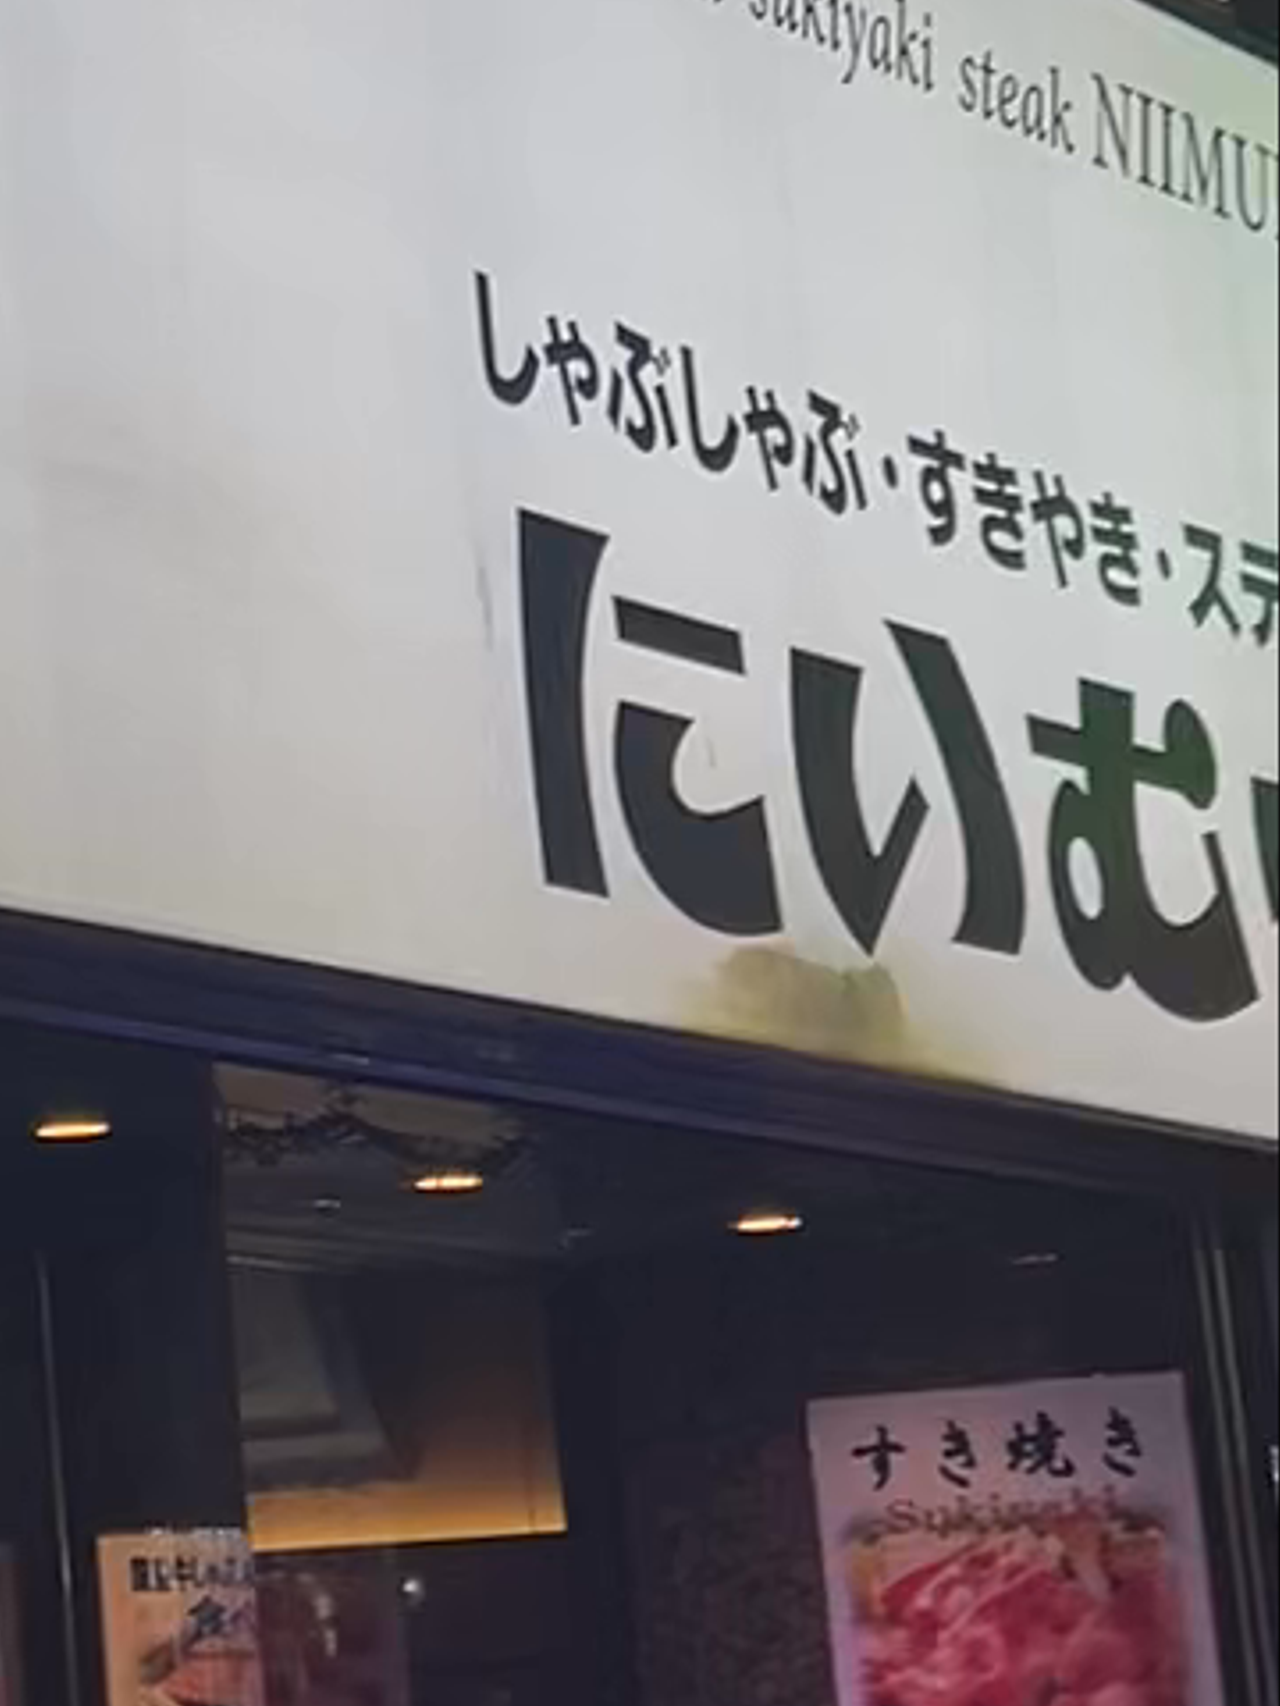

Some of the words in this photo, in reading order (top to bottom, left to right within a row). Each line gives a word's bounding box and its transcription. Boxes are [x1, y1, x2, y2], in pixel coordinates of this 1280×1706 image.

[957, 49, 1077, 156] steak
[1089, 70, 1280, 239] NIIMU
[515, 506, 1280, 1024] にいむ
[850, 1404, 1145, 1492] すき焼き
